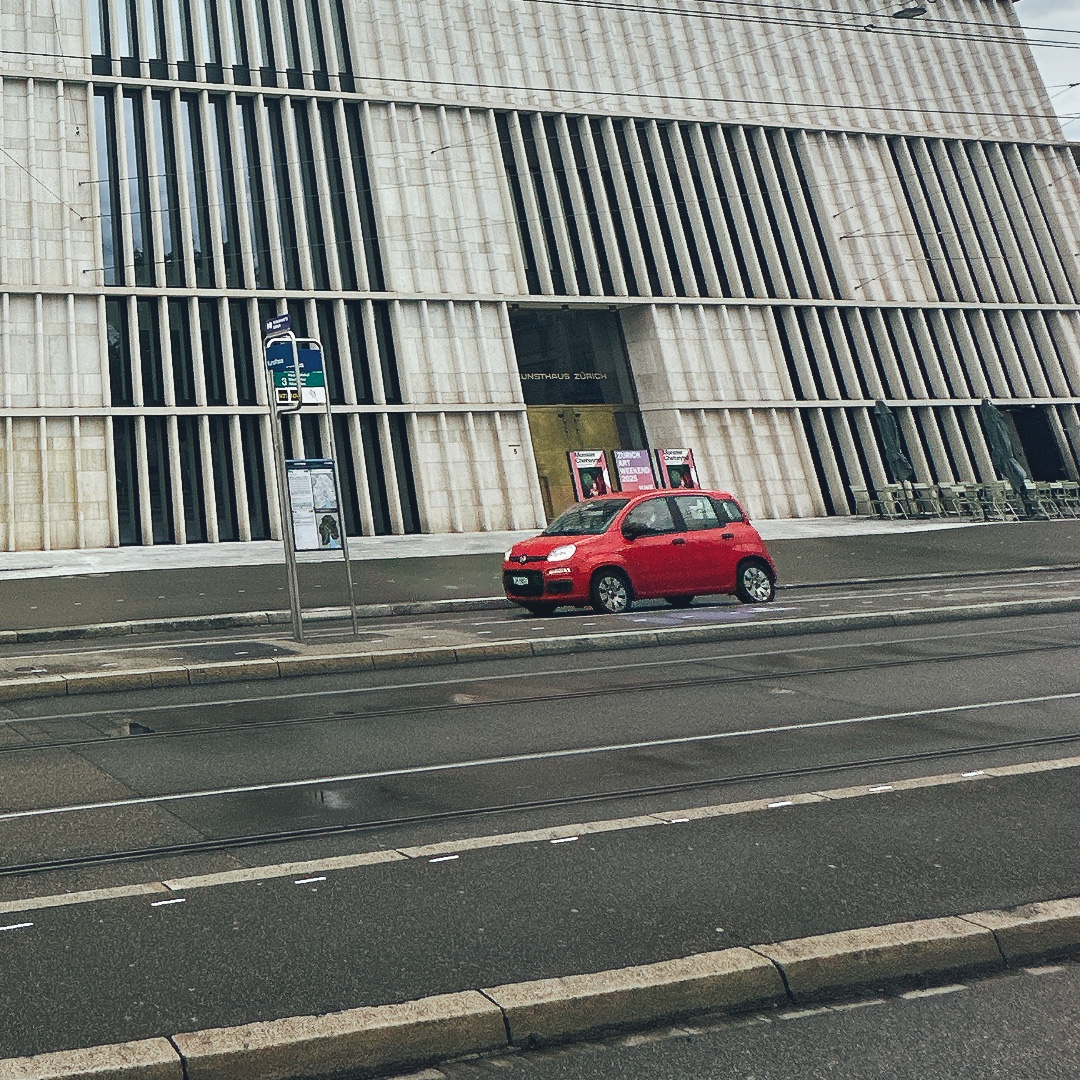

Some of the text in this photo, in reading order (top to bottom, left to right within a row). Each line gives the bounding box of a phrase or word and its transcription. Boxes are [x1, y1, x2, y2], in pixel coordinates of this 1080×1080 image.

[520, 371, 607, 380] UNSTHAUS ZÜRICH
[281, 377, 288, 386] 3
[618, 459, 631, 467] ART
